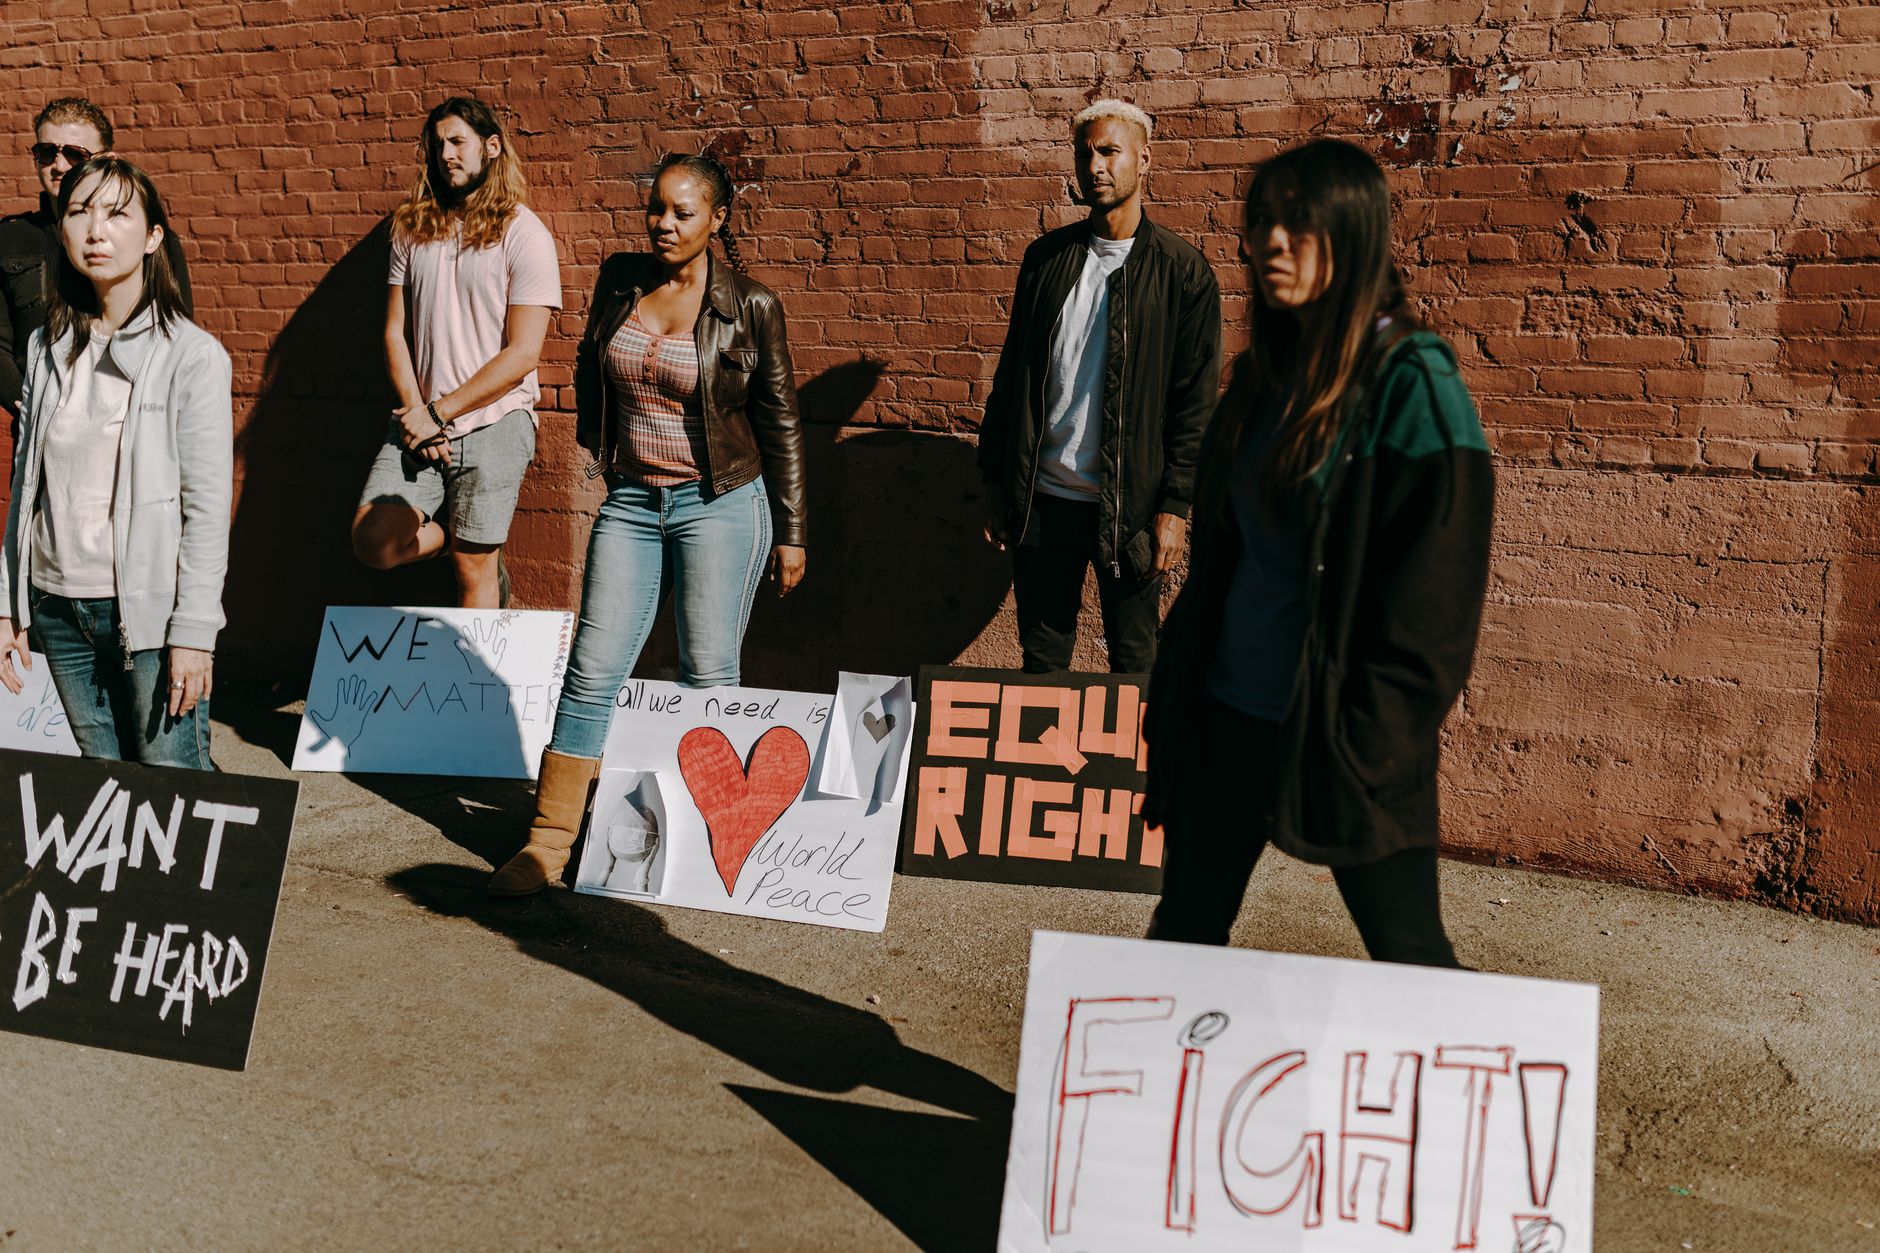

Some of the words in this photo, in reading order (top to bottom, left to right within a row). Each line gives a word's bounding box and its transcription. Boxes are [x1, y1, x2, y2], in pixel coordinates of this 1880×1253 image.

[329, 616, 434, 664] WE
[16, 705, 66, 737] are
[616, 681, 645, 710] all
[649, 694, 682, 714] we
[705, 697, 780, 720] need
[806, 702, 829, 724] is
[18, 772, 260, 892] WANT
[750, 829, 865, 880] World
[745, 867, 876, 921] Peace
[12, 891, 98, 1012] BE
[109, 919, 250, 1036] HEARD
